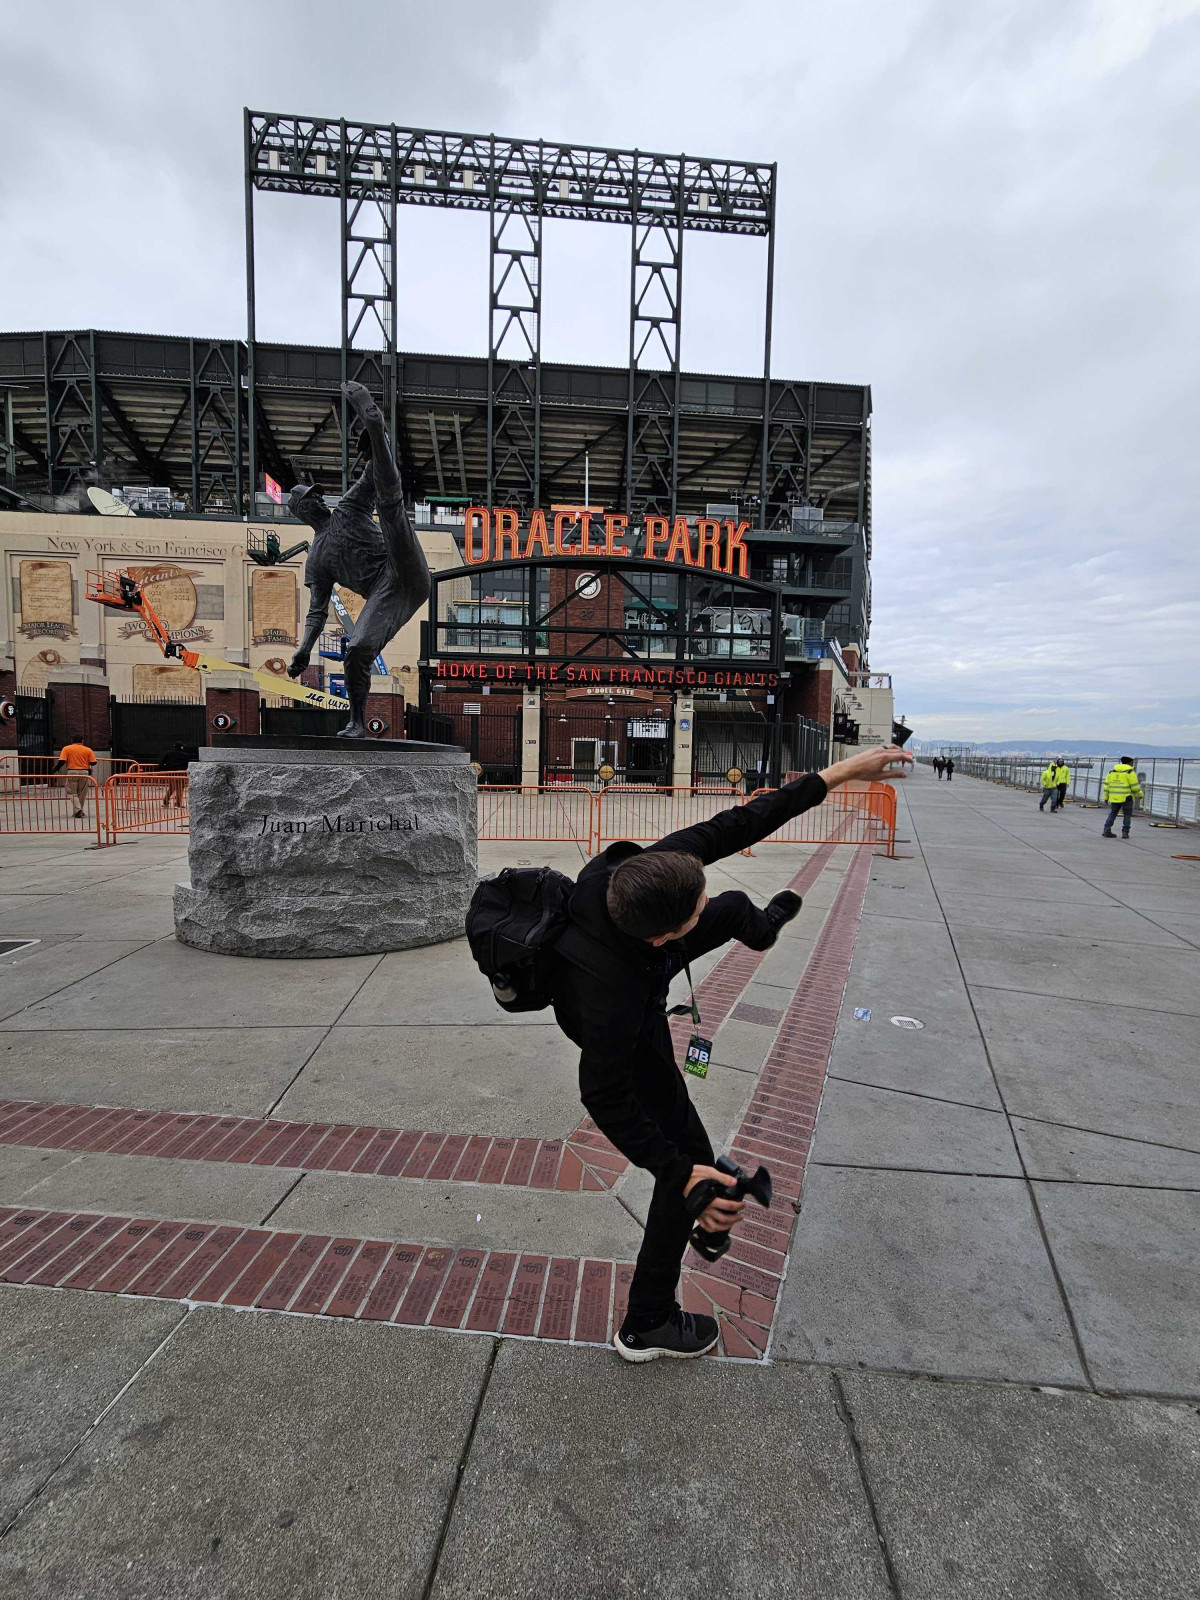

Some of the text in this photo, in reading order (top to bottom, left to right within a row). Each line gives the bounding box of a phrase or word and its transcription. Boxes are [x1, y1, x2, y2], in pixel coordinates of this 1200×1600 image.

[47, 537, 80, 550] New
[84, 539, 116, 552] York
[121, 542, 131, 552] &
[135, 540, 160, 554] San
[165, 542, 227, 557] Francisco
[464, 506, 750, 578] ORACLE PARK
[330, 594, 348, 616] S-85
[436, 662, 488, 680] HOME
[496, 664, 517, 680] OF
[524, 664, 559, 682] THE
[566, 666, 601, 682] SAN
[609, 668, 708, 686] FRANCISCO
[714, 670, 778, 688] GIANTS
[305, 692, 350, 710] JLG ULTR
[258, 814, 422, 836] Juan Marichal
[698, 1050, 709, 1063] B
[684, 1064, 706, 1076] TRACK
